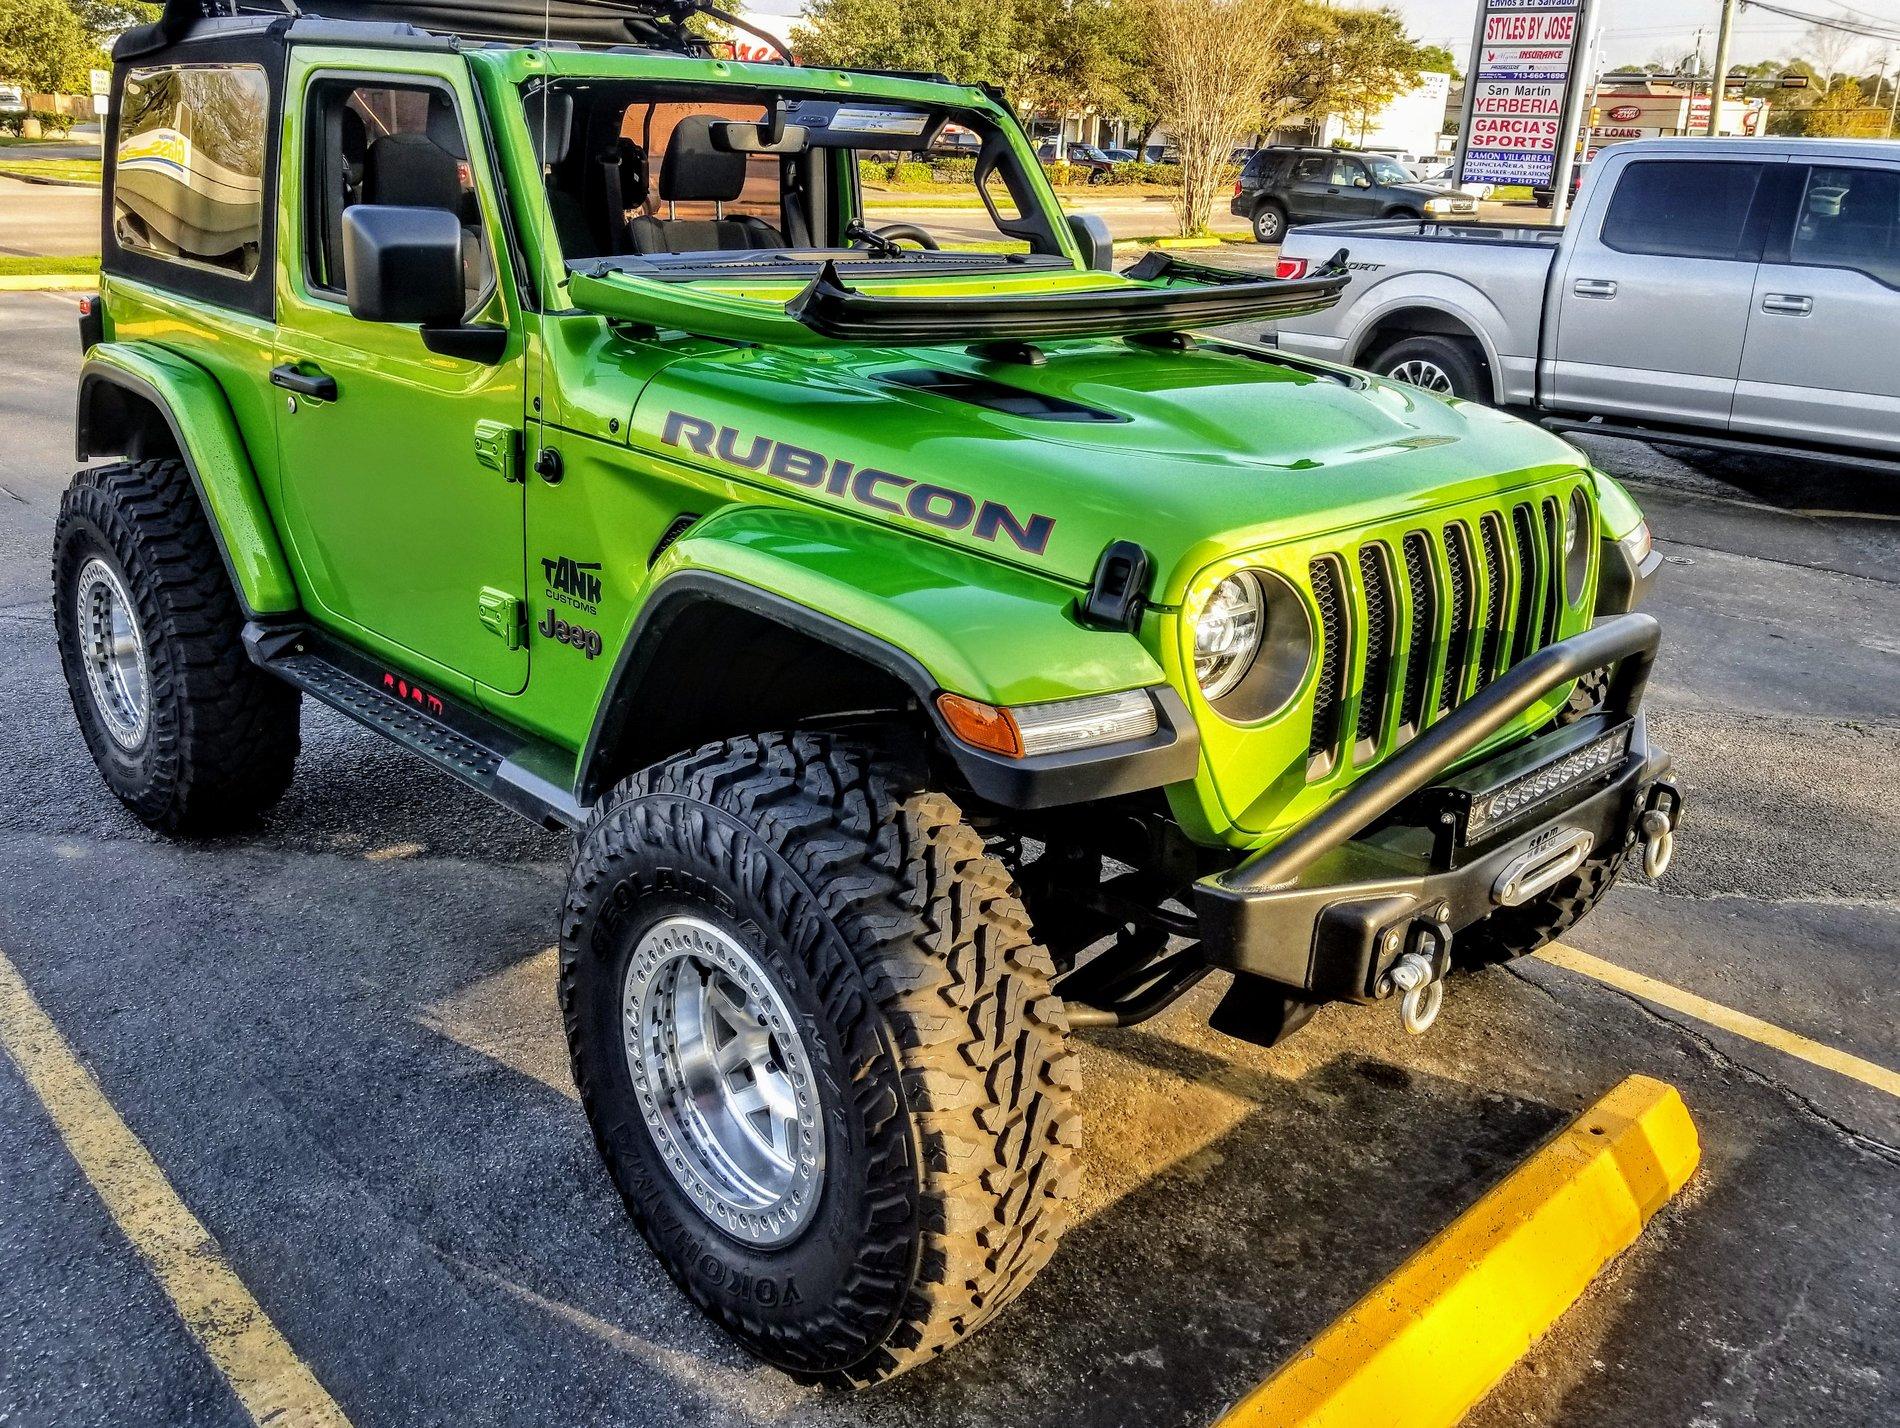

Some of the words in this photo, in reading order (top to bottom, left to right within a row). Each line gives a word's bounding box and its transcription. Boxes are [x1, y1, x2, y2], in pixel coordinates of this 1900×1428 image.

[1488, 17, 1526, 40] STYLES
[1528, 17, 1543, 40] BY
[1545, 16, 1573, 40] JOSE
[1519, 51, 1563, 59] INSURANCE
[1488, 85, 1509, 96] San
[1515, 85, 1551, 96] Martin
[1476, 98, 1559, 113] YERBERIA
[1475, 120, 1557, 135] GARCIA'S
[1605, 128, 1641, 138] LOANS
[1472, 135, 1554, 149] SPORTS
[1468, 151, 1500, 160] RAMON
[1503, 153, 1552, 162] VILLARREAL
[661, 410, 1056, 556] RUBICON
[541, 556, 602, 604] TANK
[545, 588, 597, 615] CUSTOMS
[538, 608, 602, 660] Jeep
